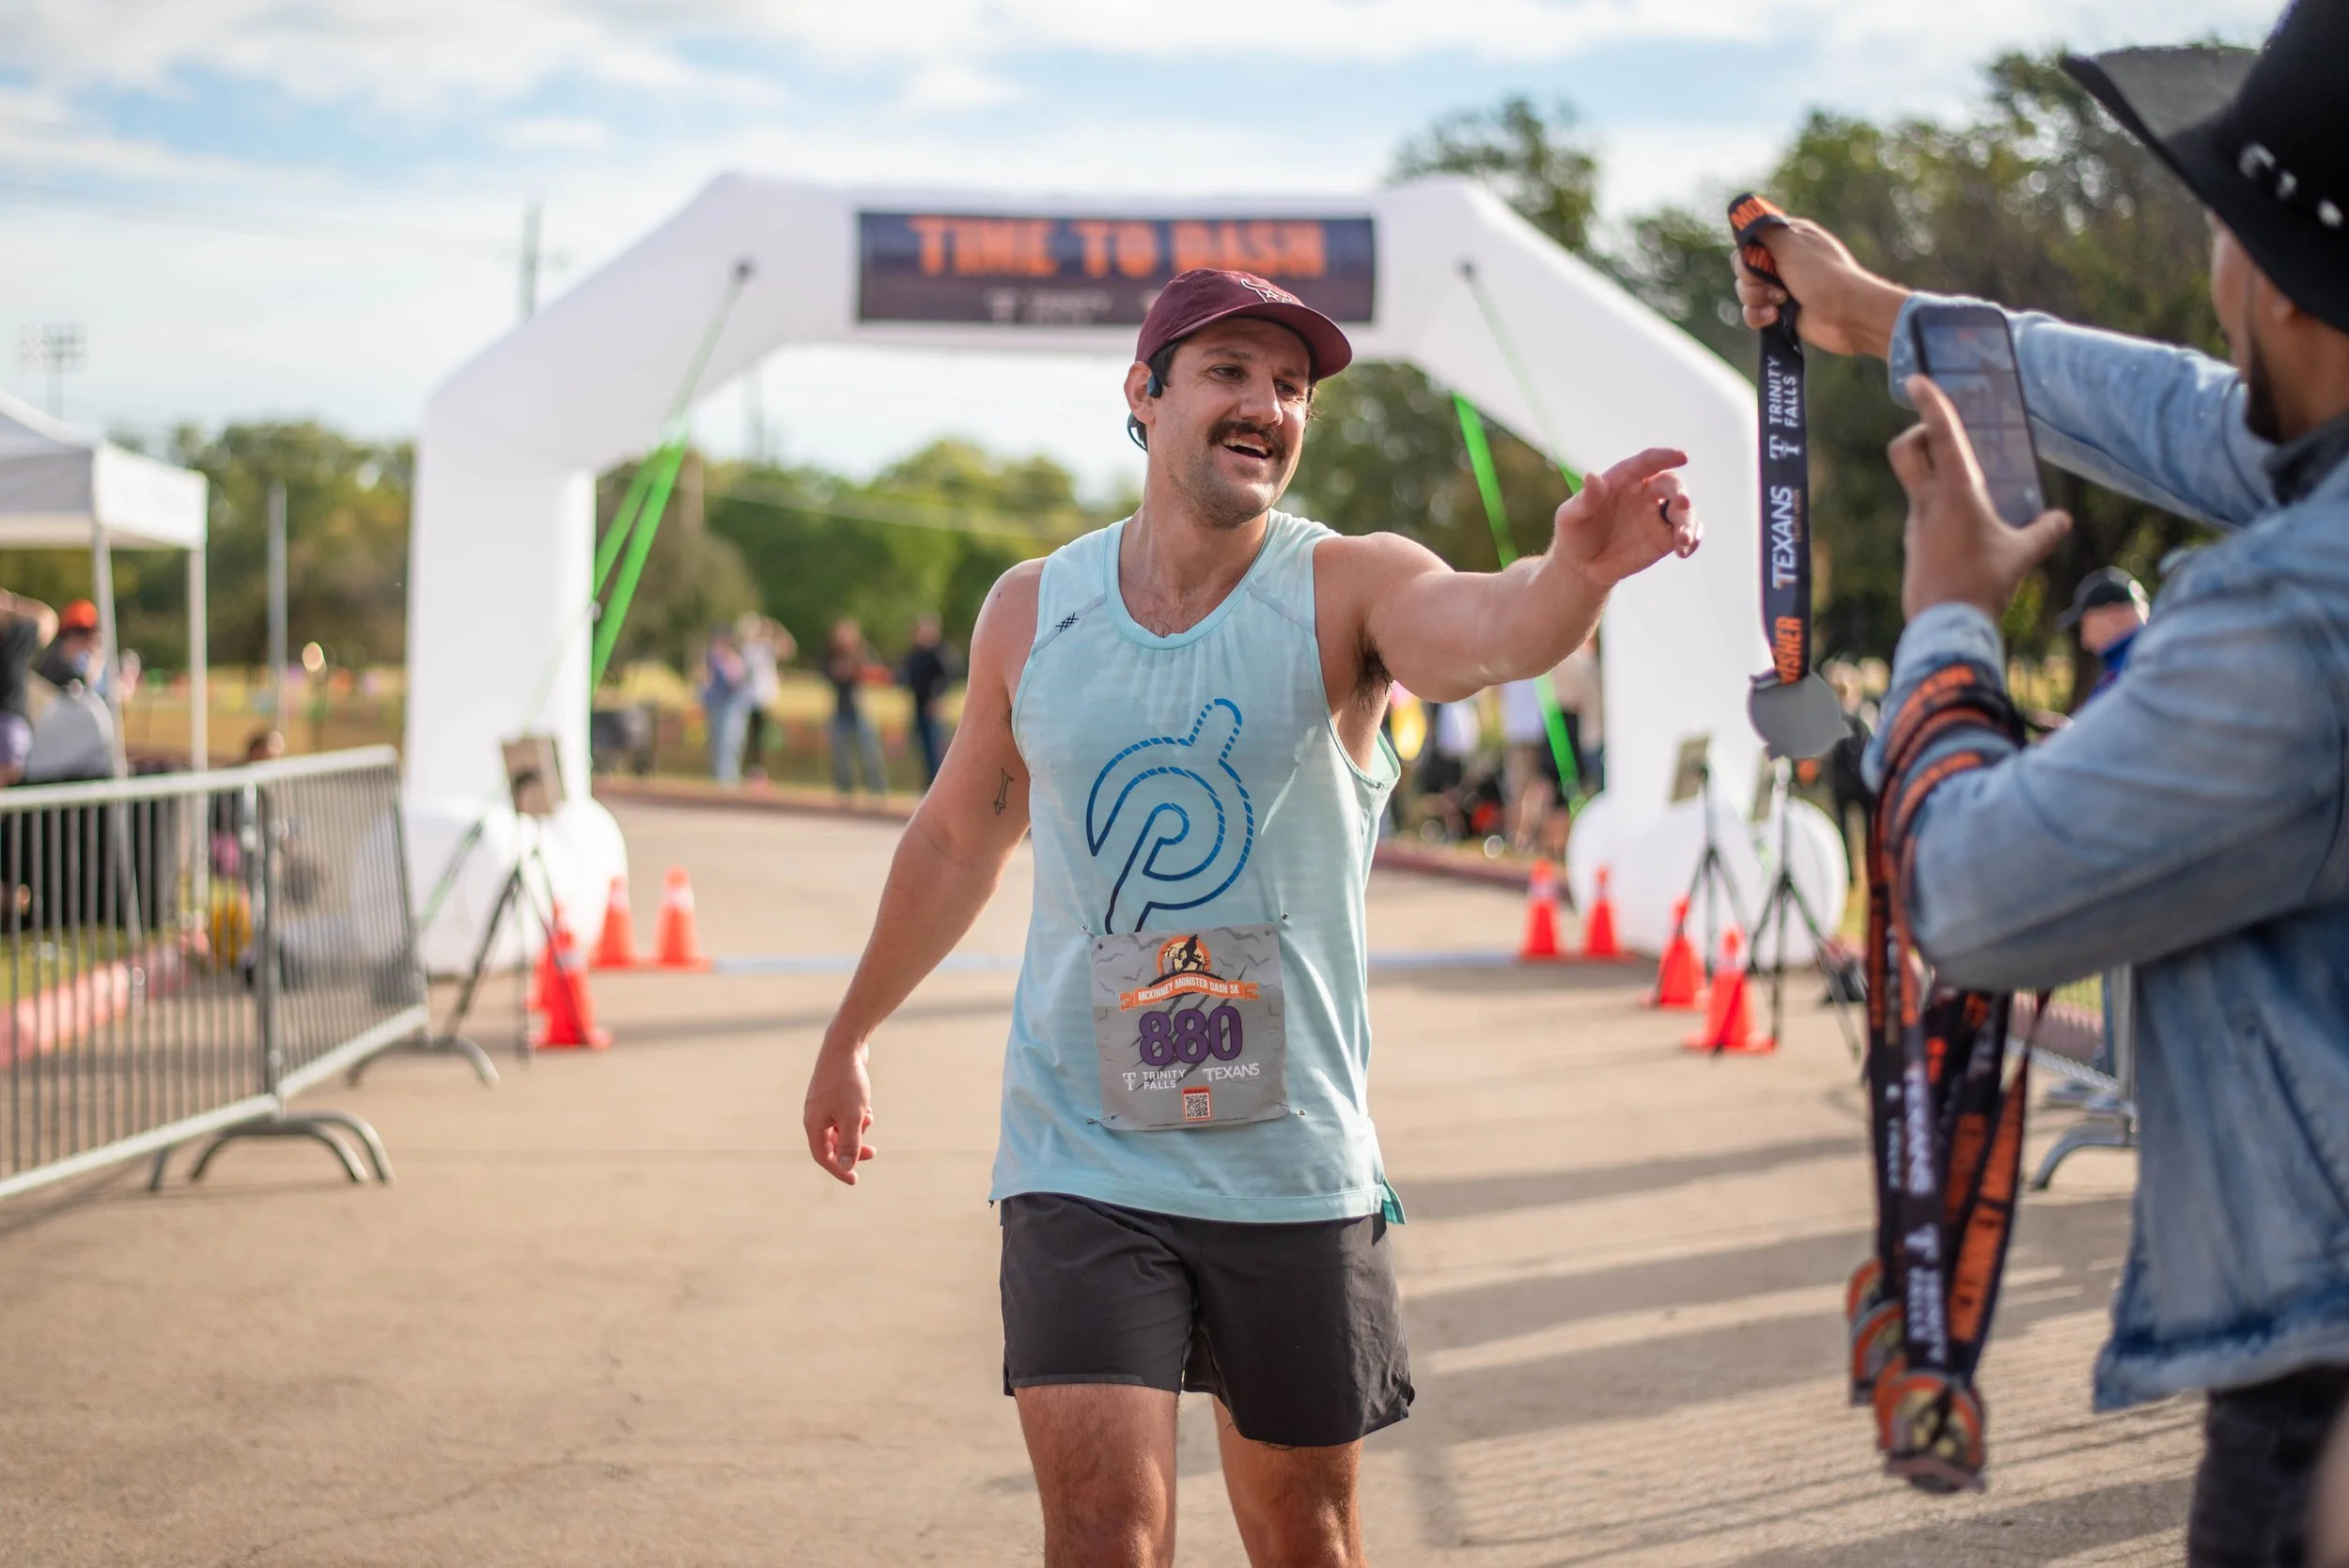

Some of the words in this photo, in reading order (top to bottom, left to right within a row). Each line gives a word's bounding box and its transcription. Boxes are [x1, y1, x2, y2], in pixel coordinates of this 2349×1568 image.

[910, 217, 1058, 276] TIME
[1072, 223, 1159, 277] TO
[1767, 355, 1782, 426] TRINITY
[1783, 375, 1799, 427] FALLS
[1770, 485, 1799, 590] TEXANS
[1138, 982, 1174, 1001] MCKINNEY
[1174, 976, 1208, 989] MONSTER
[1209, 981, 1228, 994] DASH
[1229, 984, 1240, 994] 5K
[1139, 1005, 1243, 1066] 880
[1143, 1069, 1186, 1080] TRINITY
[1143, 1079, 1176, 1091] FALLS
[1203, 1063, 1260, 1081] TEXANS
